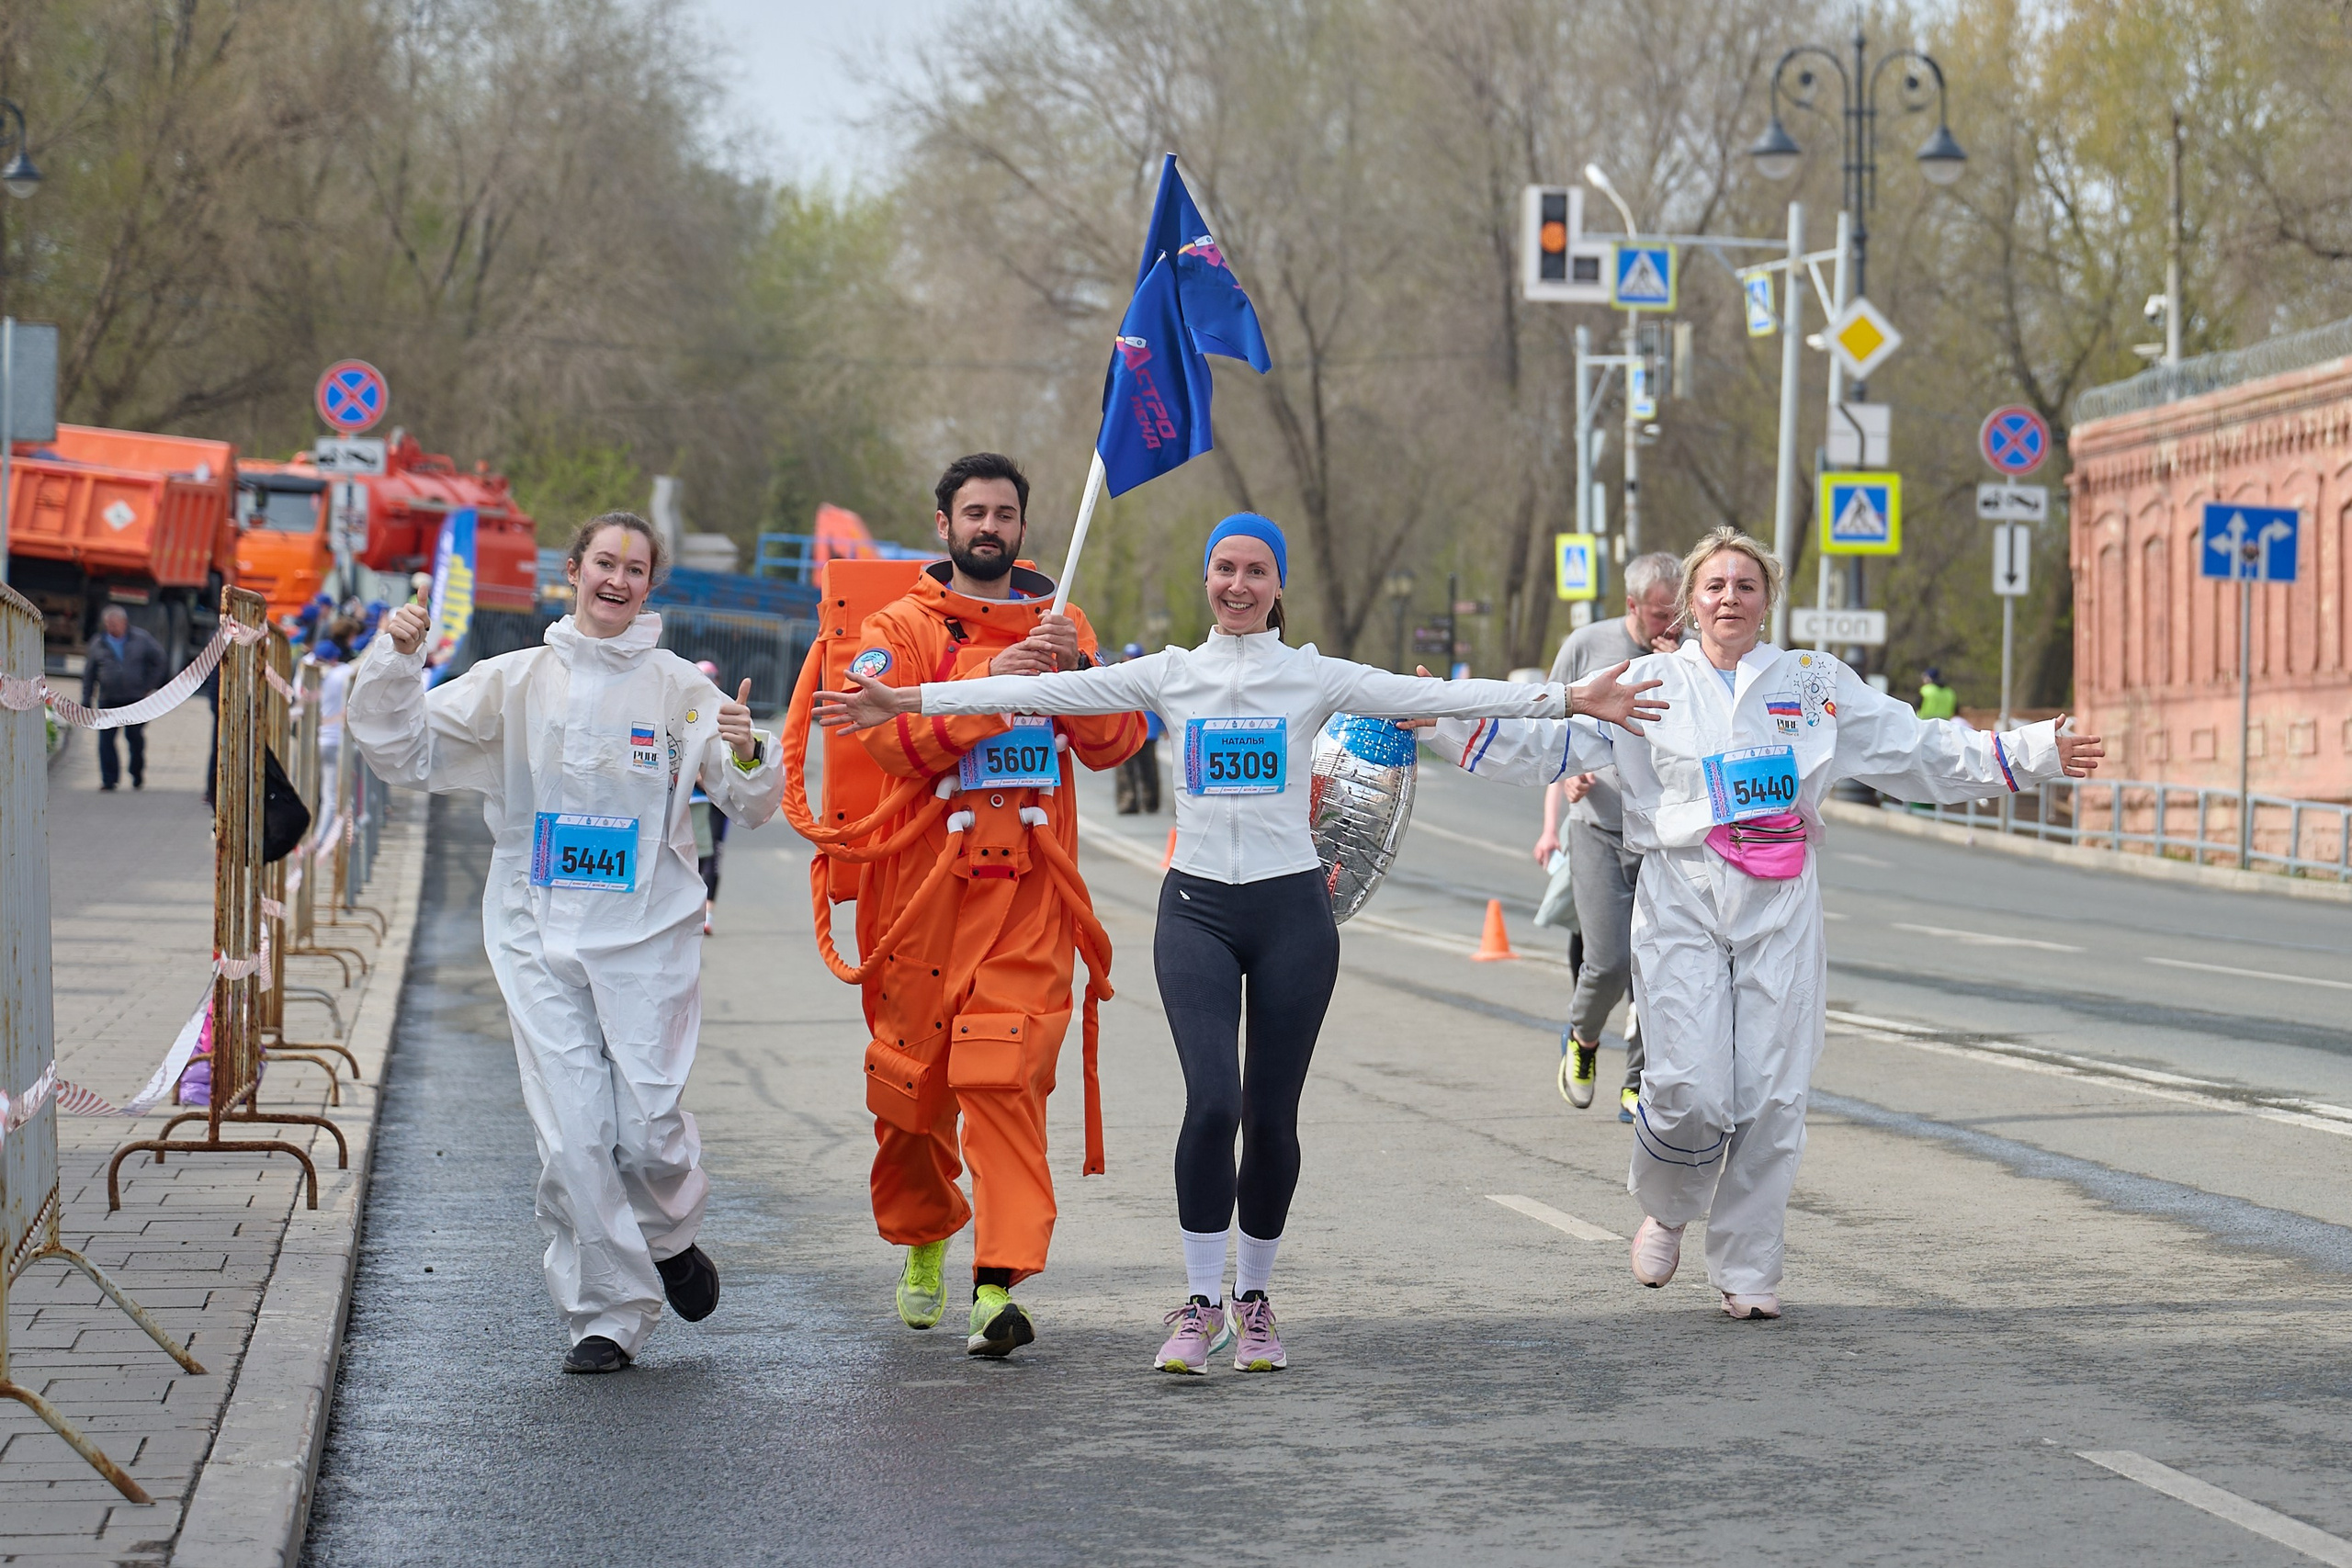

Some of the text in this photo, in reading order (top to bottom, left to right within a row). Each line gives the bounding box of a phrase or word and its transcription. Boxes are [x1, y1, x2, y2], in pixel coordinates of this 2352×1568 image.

[1115, 337, 1177, 439] АСТРО
[1805, 615, 1871, 636] СТОП
[1222, 738, 1265, 746] НАТАЛЬЯ
[987, 746, 1049, 773] 5607
[1209, 751, 1278, 780] 5309
[1734, 774, 1794, 806] 5440
[561, 846, 626, 876] 5441
